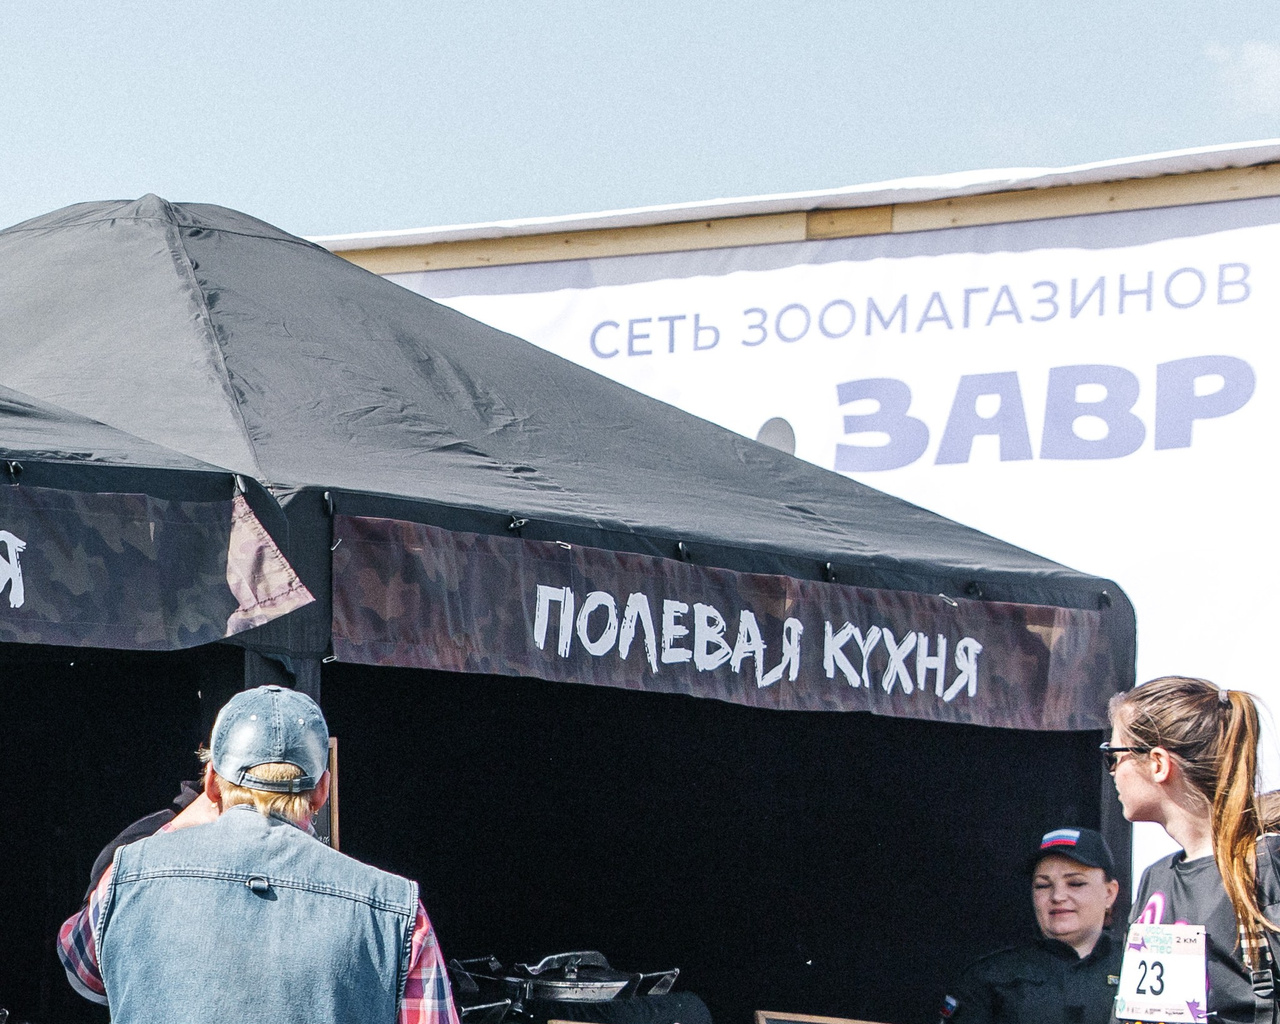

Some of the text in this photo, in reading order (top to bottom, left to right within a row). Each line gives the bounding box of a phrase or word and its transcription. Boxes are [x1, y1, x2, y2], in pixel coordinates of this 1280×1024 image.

[589, 262, 1252, 359] СЕТЬ ЗООМАГАЗИНОВ
[834, 354, 1257, 473] ЗАВР
[532, 583, 983, 702] ПОЛЕВАЯ КУХНЯ
[1136, 959, 1165, 996] 23
